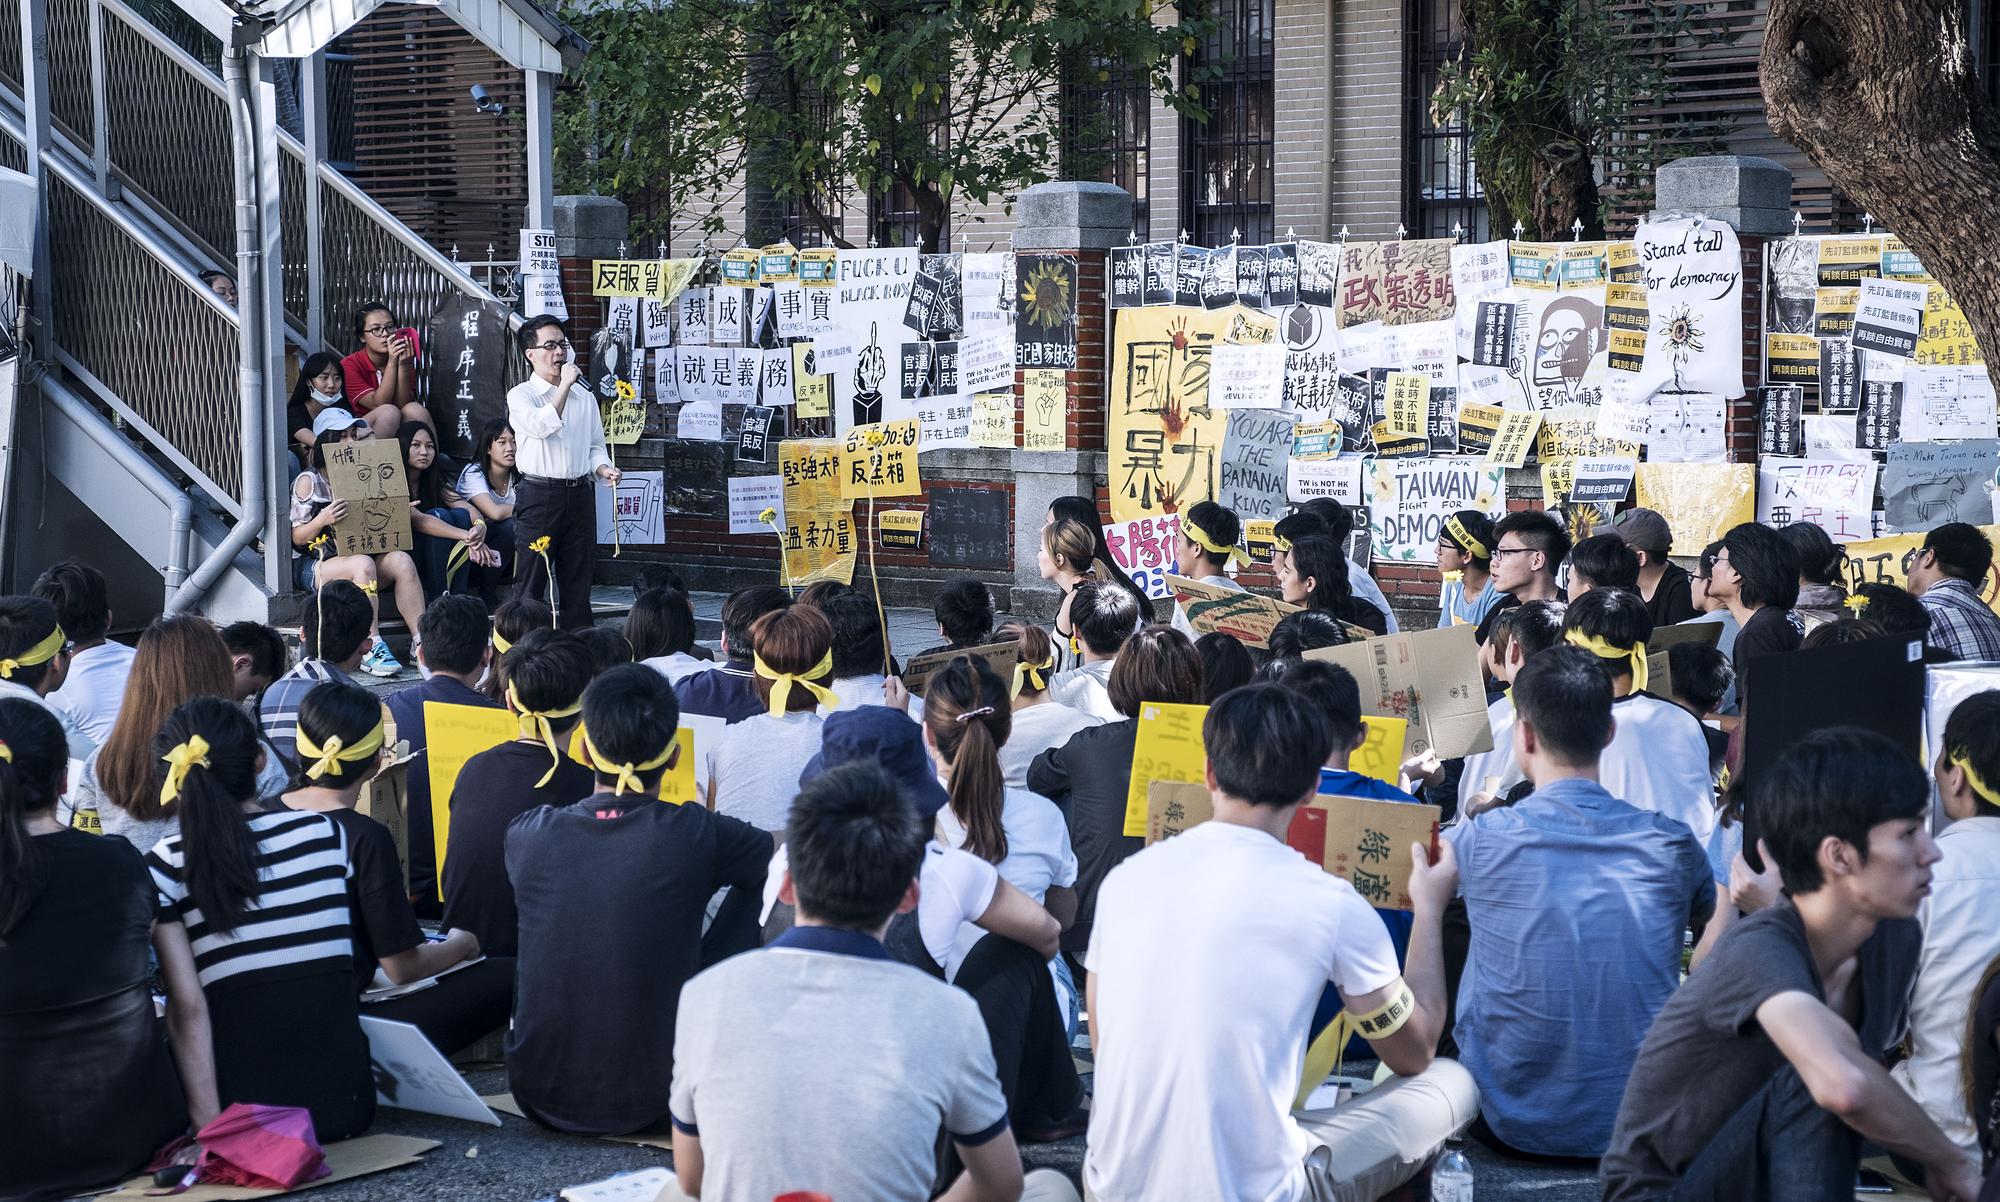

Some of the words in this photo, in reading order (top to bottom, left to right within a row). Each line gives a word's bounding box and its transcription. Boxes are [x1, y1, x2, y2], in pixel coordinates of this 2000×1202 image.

[1512, 248, 1540, 258] TAIWAN
[1564, 248, 1593, 258] TAIWAN
[1643, 230, 1689, 262] Stand
[1693, 230, 1723, 254] tall
[1824, 244, 1878, 258] 先訂監督條例
[801, 253, 821, 261] TAIWAN
[1147, 257, 1173, 274] 官逼
[1268, 256, 1296, 275] 政府
[841, 256, 888, 282] FUCK
[894, 256, 908, 276] U
[1114, 260, 1139, 277] 政府
[1238, 260, 1264, 277] 政府
[1821, 268, 1878, 282] 再談自由貿易
[596, 262, 660, 296] 反服貿
[1146, 275, 1172, 292] 民反
[1176, 278, 1197, 296] 民反
[1645, 267, 1667, 292] for
[1669, 262, 1741, 302] democracy
[841, 287, 881, 305] BLACK
[882, 282, 911, 300] BOX
[1342, 268, 1456, 313] 政策透明
[1866, 284, 1922, 303] 先訂監督條例
[1862, 304, 1917, 327] 先訂監督條例
[1856, 329, 1914, 351] 再談自由貿易
[903, 353, 929, 371] 官逼
[999, 361, 1011, 371] HK
[1431, 362, 1445, 371] HK
[455, 310, 480, 440] 程序正義
[903, 371, 928, 388] 民反
[967, 374, 990, 387] NEVER
[1337, 385, 1367, 410] 政府
[1764, 390, 1777, 453] 拒絕不實報導
[1779, 389, 1791, 454] 尊重多元聲音
[1865, 383, 1880, 449] 拒絕不實報導
[1879, 383, 1894, 451] 尊重多元聲音
[744, 417, 767, 434] 官逼
[1230, 411, 1259, 440] YOU
[1257, 420, 1294, 446] ARE
[1297, 427, 1324, 437] TAIWAN
[741, 434, 763, 450] 民反
[1237, 444, 1273, 467] THE
[1396, 459, 1434, 470] FIGHT
[1912, 449, 1935, 462] Make
[851, 452, 905, 487] 反黑箱
[1120, 427, 1216, 511] 暴力
[1582, 462, 1630, 477] 先訂監督條例
[1298, 479, 1311, 487] TW
[1311, 479, 1318, 487] is
[1320, 480, 1336, 488] NOT
[1337, 480, 1349, 489] HK
[1394, 469, 1479, 503] TAIWAN
[1577, 483, 1624, 498] 再談自由貿易
[1774, 463, 1868, 500] 反服貿
[1300, 488, 1326, 496] NEVER
[1328, 489, 1348, 497] EVER
[1232, 491, 1273, 515] KING
[1398, 501, 1429, 513] FIGHT
[1441, 500, 1463, 509] FOR
[1771, 503, 1862, 541] 要民主
[784, 519, 852, 556] 溫柔力量
